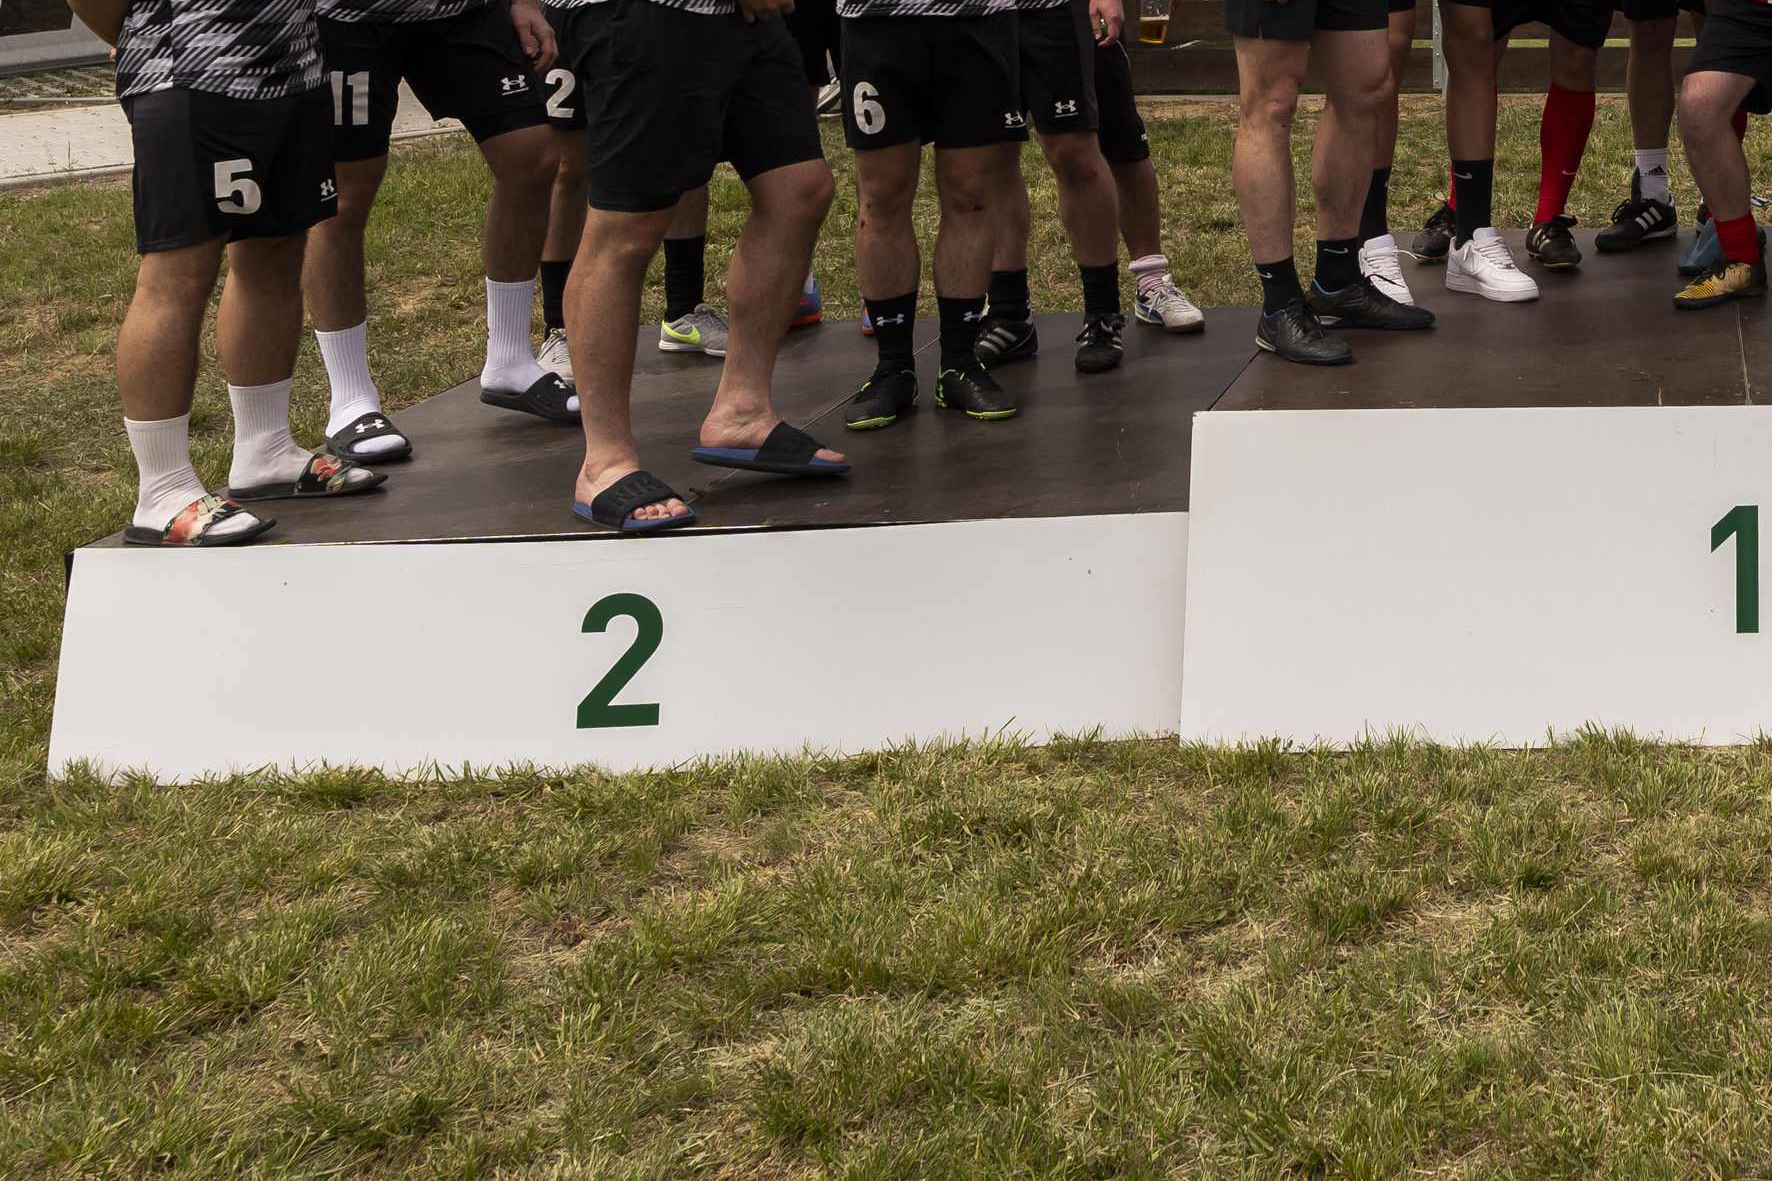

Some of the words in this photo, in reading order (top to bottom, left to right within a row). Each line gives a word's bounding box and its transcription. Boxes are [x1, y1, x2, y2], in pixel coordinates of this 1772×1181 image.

[330, 71, 369, 125] 11
[545, 68, 576, 118] 2
[853, 81, 886, 135] 6
[213, 158, 262, 215] 5
[608, 475, 665, 507] NIK
[1709, 505, 1759, 634] 1
[576, 592, 664, 730] 2
